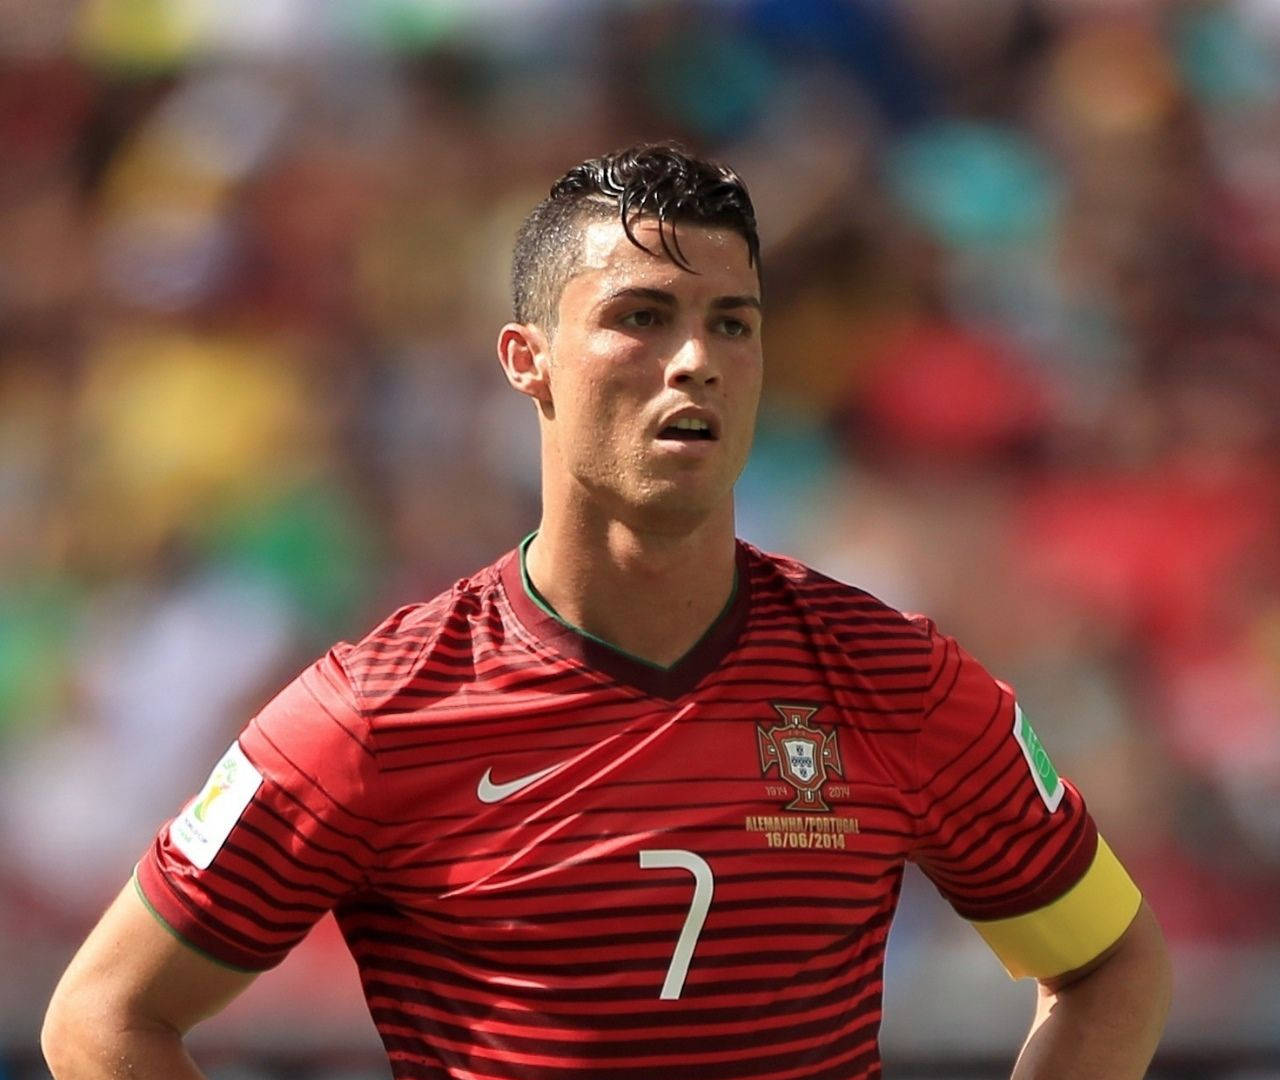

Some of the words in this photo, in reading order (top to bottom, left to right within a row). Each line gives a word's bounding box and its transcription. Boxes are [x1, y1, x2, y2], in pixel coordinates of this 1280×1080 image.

[828, 786, 850, 798] 2014
[765, 832, 846, 849] 16/06/2014
[639, 850, 714, 1000] 7
